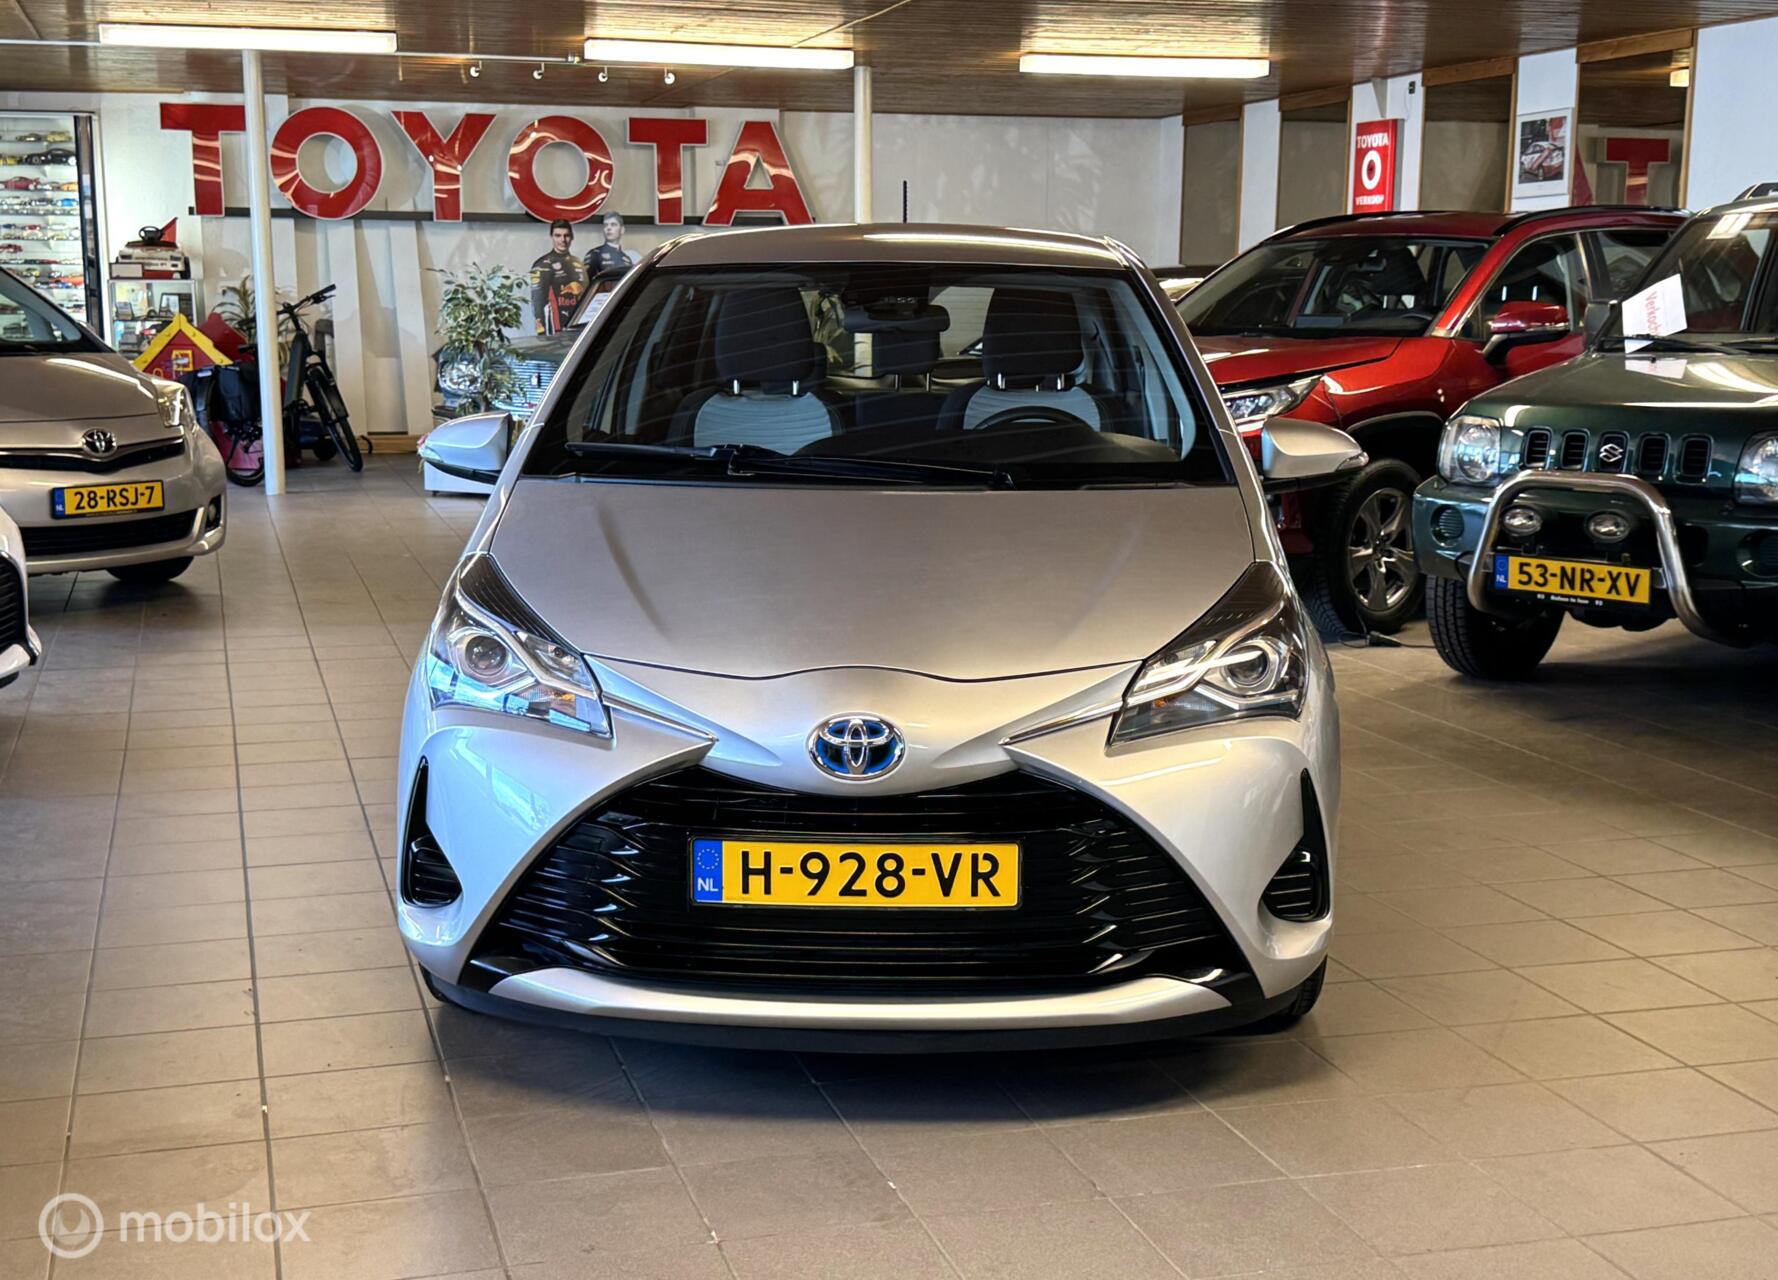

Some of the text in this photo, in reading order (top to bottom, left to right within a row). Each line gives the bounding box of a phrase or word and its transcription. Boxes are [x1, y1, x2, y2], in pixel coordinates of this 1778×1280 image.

[1356, 132, 1389, 149] TOYOTA
[160, 102, 814, 226] TOYOTA
[74, 485, 156, 511] 28-RSJ-7
[1496, 574, 1507, 584] NL
[1517, 561, 1641, 598] 53-NR-XV
[697, 877, 719, 892] NL
[740, 850, 1002, 899] H-928-VR
